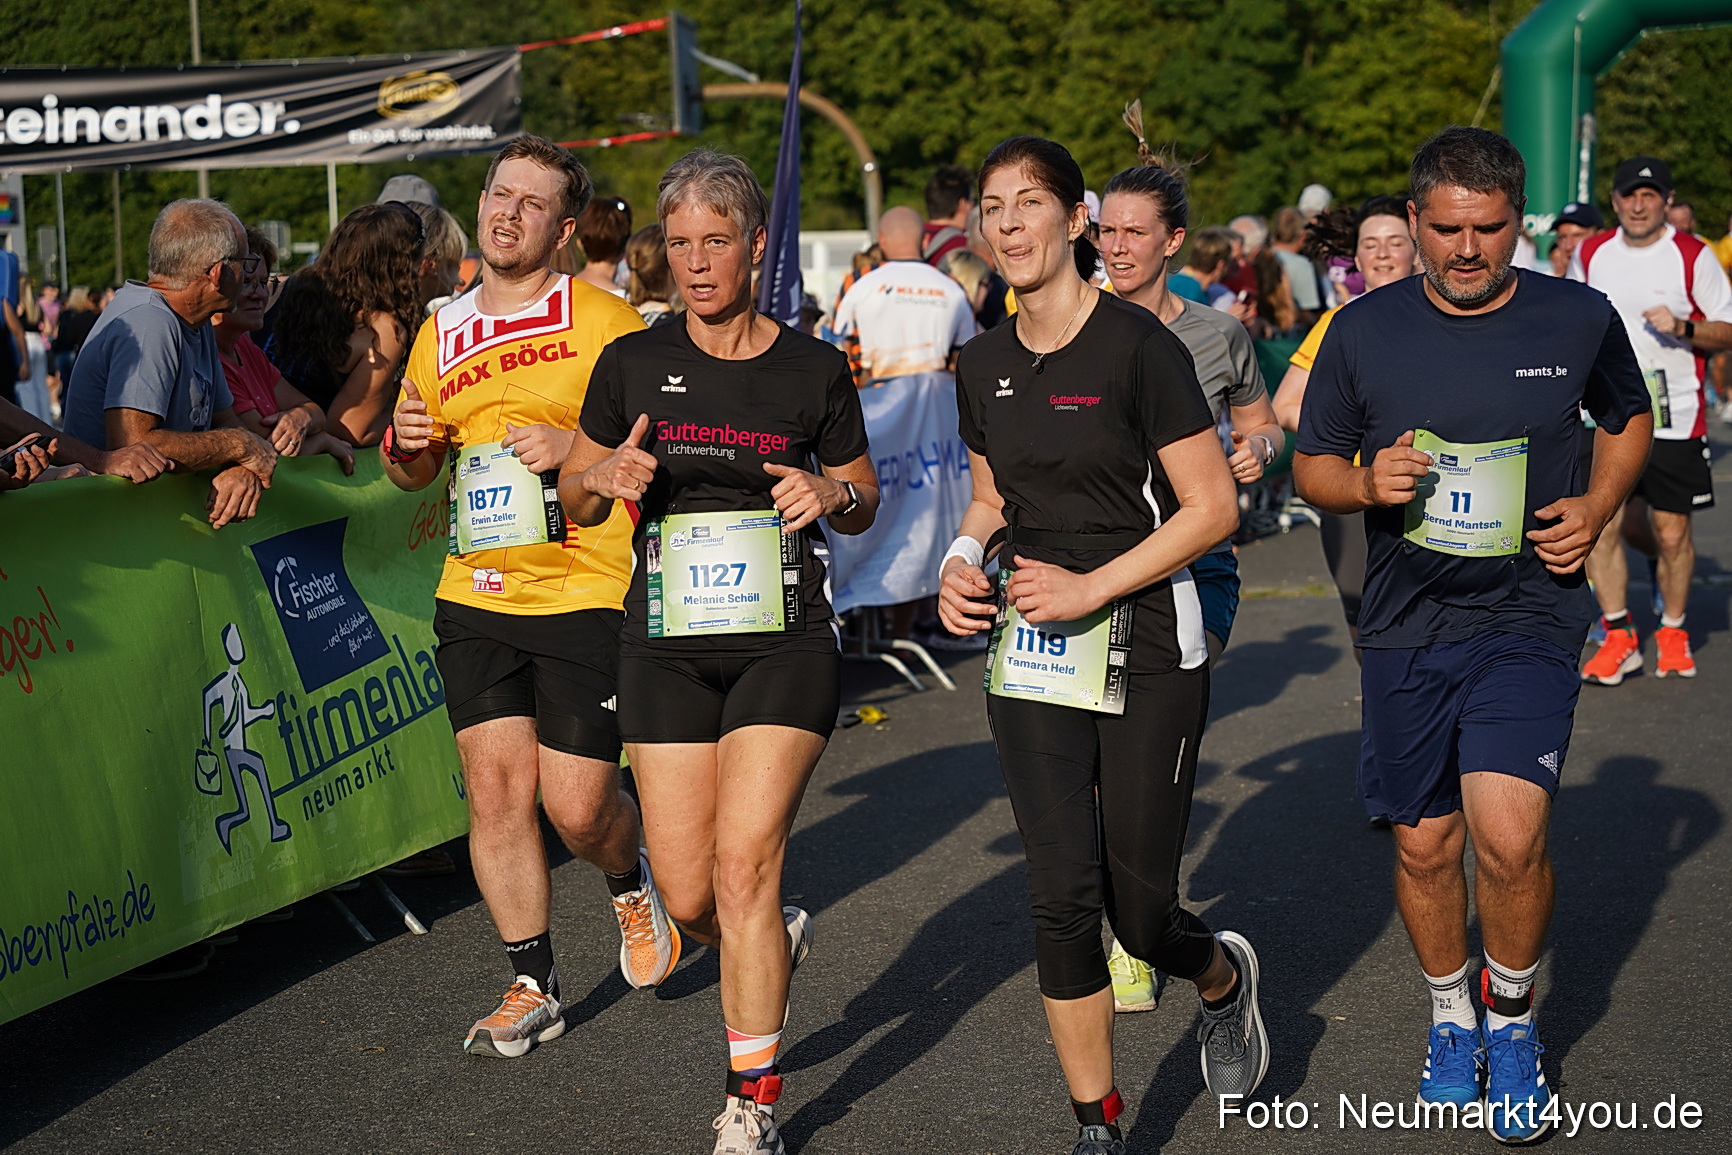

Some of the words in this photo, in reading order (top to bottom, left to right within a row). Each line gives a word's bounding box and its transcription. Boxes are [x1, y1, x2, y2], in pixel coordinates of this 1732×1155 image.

[0, 94, 300, 144] einander.
[440, 360, 493, 407] MAX
[499, 341, 578, 373] BÖGL
[1515, 365, 1568, 378] mants_be
[661, 385, 687, 393] erima
[995, 388, 1014, 397] erima
[1049, 394, 1101, 407] Guttenberger
[656, 420, 790, 455] Guttenberger
[667, 444, 736, 461] Lichtwerbung
[1434, 463, 1472, 472] Firmenlauf
[467, 485, 512, 511] 1877
[1450, 491, 1471, 513] 11
[471, 515, 491, 526] Erwin
[493, 513, 516, 522] Zeller
[548, 504, 558, 535] HILTL
[1423, 512, 1451, 526] Bernd
[1455, 520, 1502, 530] Mantsch
[687, 535, 724, 546] Firmenlauf
[689, 563, 747, 588] 1127
[288, 572, 339, 609] Fischer
[683, 595, 725, 605] Melanie
[727, 593, 760, 603] Schöll
[306, 594, 346, 622] AUTOMOBILE
[788, 588, 796, 623] HILTL
[0, 586, 75, 694] ger!
[1015, 626, 1067, 657] 1119
[1110, 633, 1116, 644] 20
[1007, 656, 1048, 671] Tamara
[1051, 663, 1075, 675] Held
[1108, 669, 1119, 704] HILTL
[276, 634, 446, 782] firmenla
[302, 743, 395, 821] neumarkt
